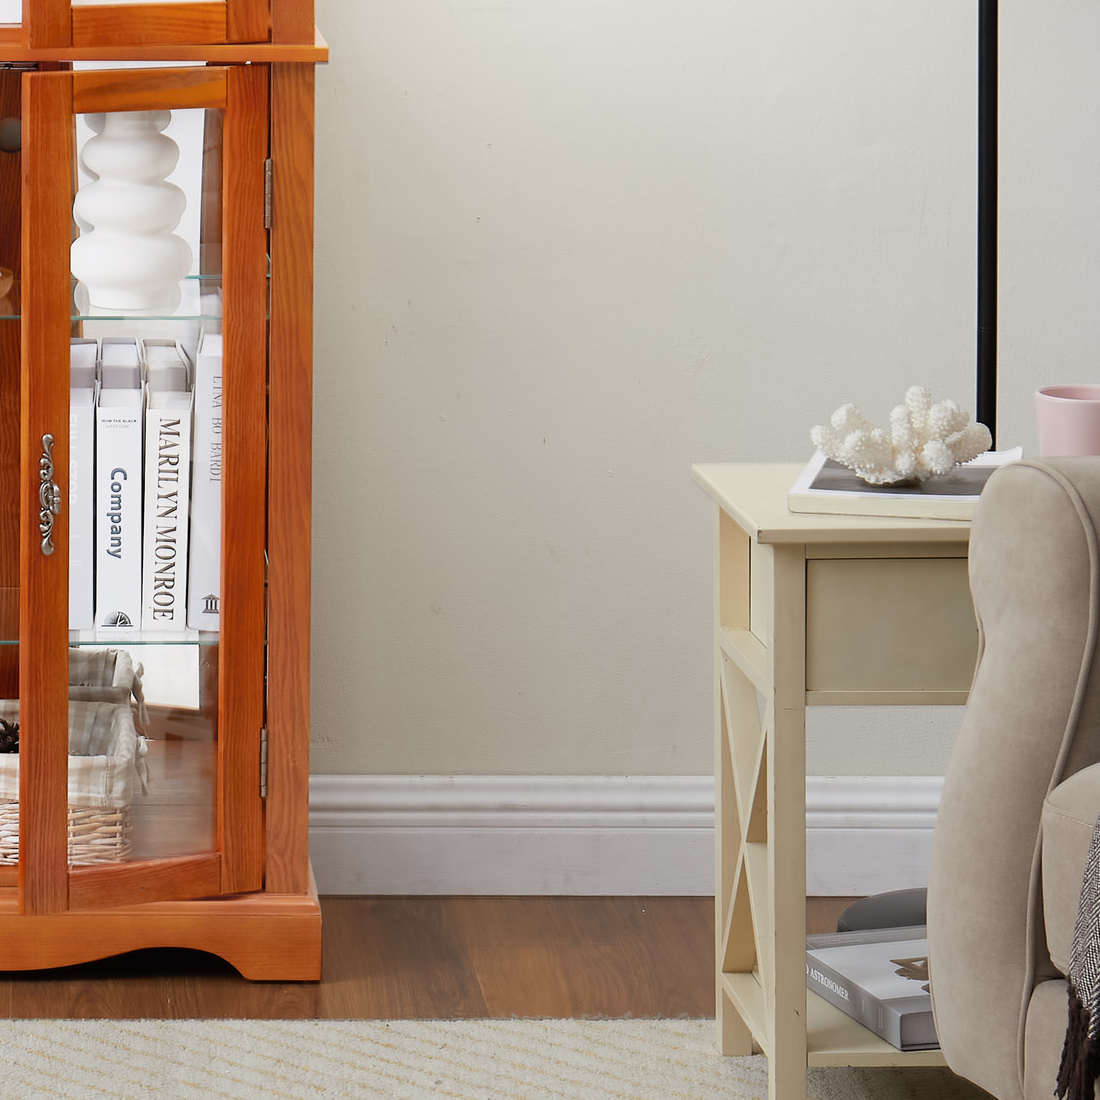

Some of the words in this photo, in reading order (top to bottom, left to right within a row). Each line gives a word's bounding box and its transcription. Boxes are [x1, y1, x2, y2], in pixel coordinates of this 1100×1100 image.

[106, 467, 128, 559] Company
[156, 418, 181, 520] MARILYN
[152, 525, 177, 621] MONROE
